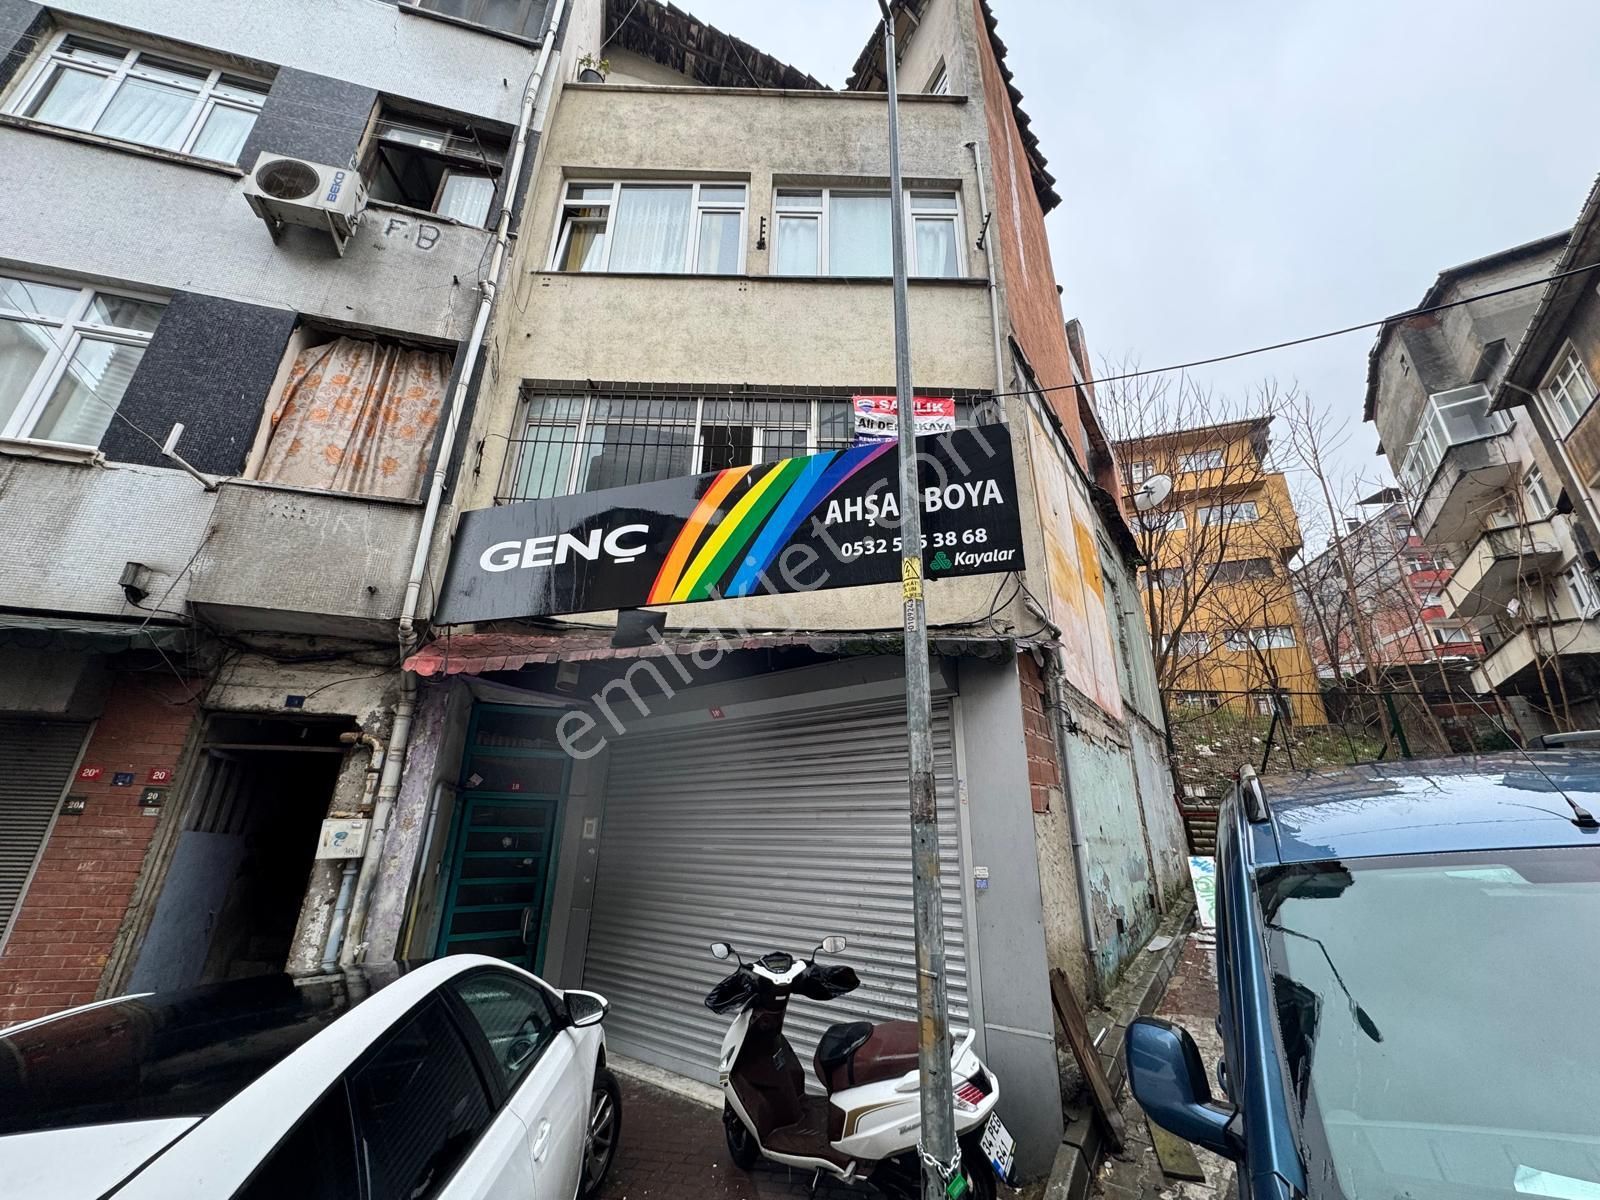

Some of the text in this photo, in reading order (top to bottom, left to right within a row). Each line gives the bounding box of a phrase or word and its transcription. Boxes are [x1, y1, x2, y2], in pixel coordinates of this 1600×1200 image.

[327, 171, 345, 202] BEKO
[824, 479, 1004, 527] AHŞA BOYA
[479, 524, 650, 573] GENÇ
[841, 527, 988, 557] 0532 55 38 68
[954, 548, 1016, 568] Kayalar
[152, 771, 166, 779] 20
[147, 792, 158, 800] 20
[982, 1134, 994, 1156] 34
[995, 1139, 1009, 1166] 641
